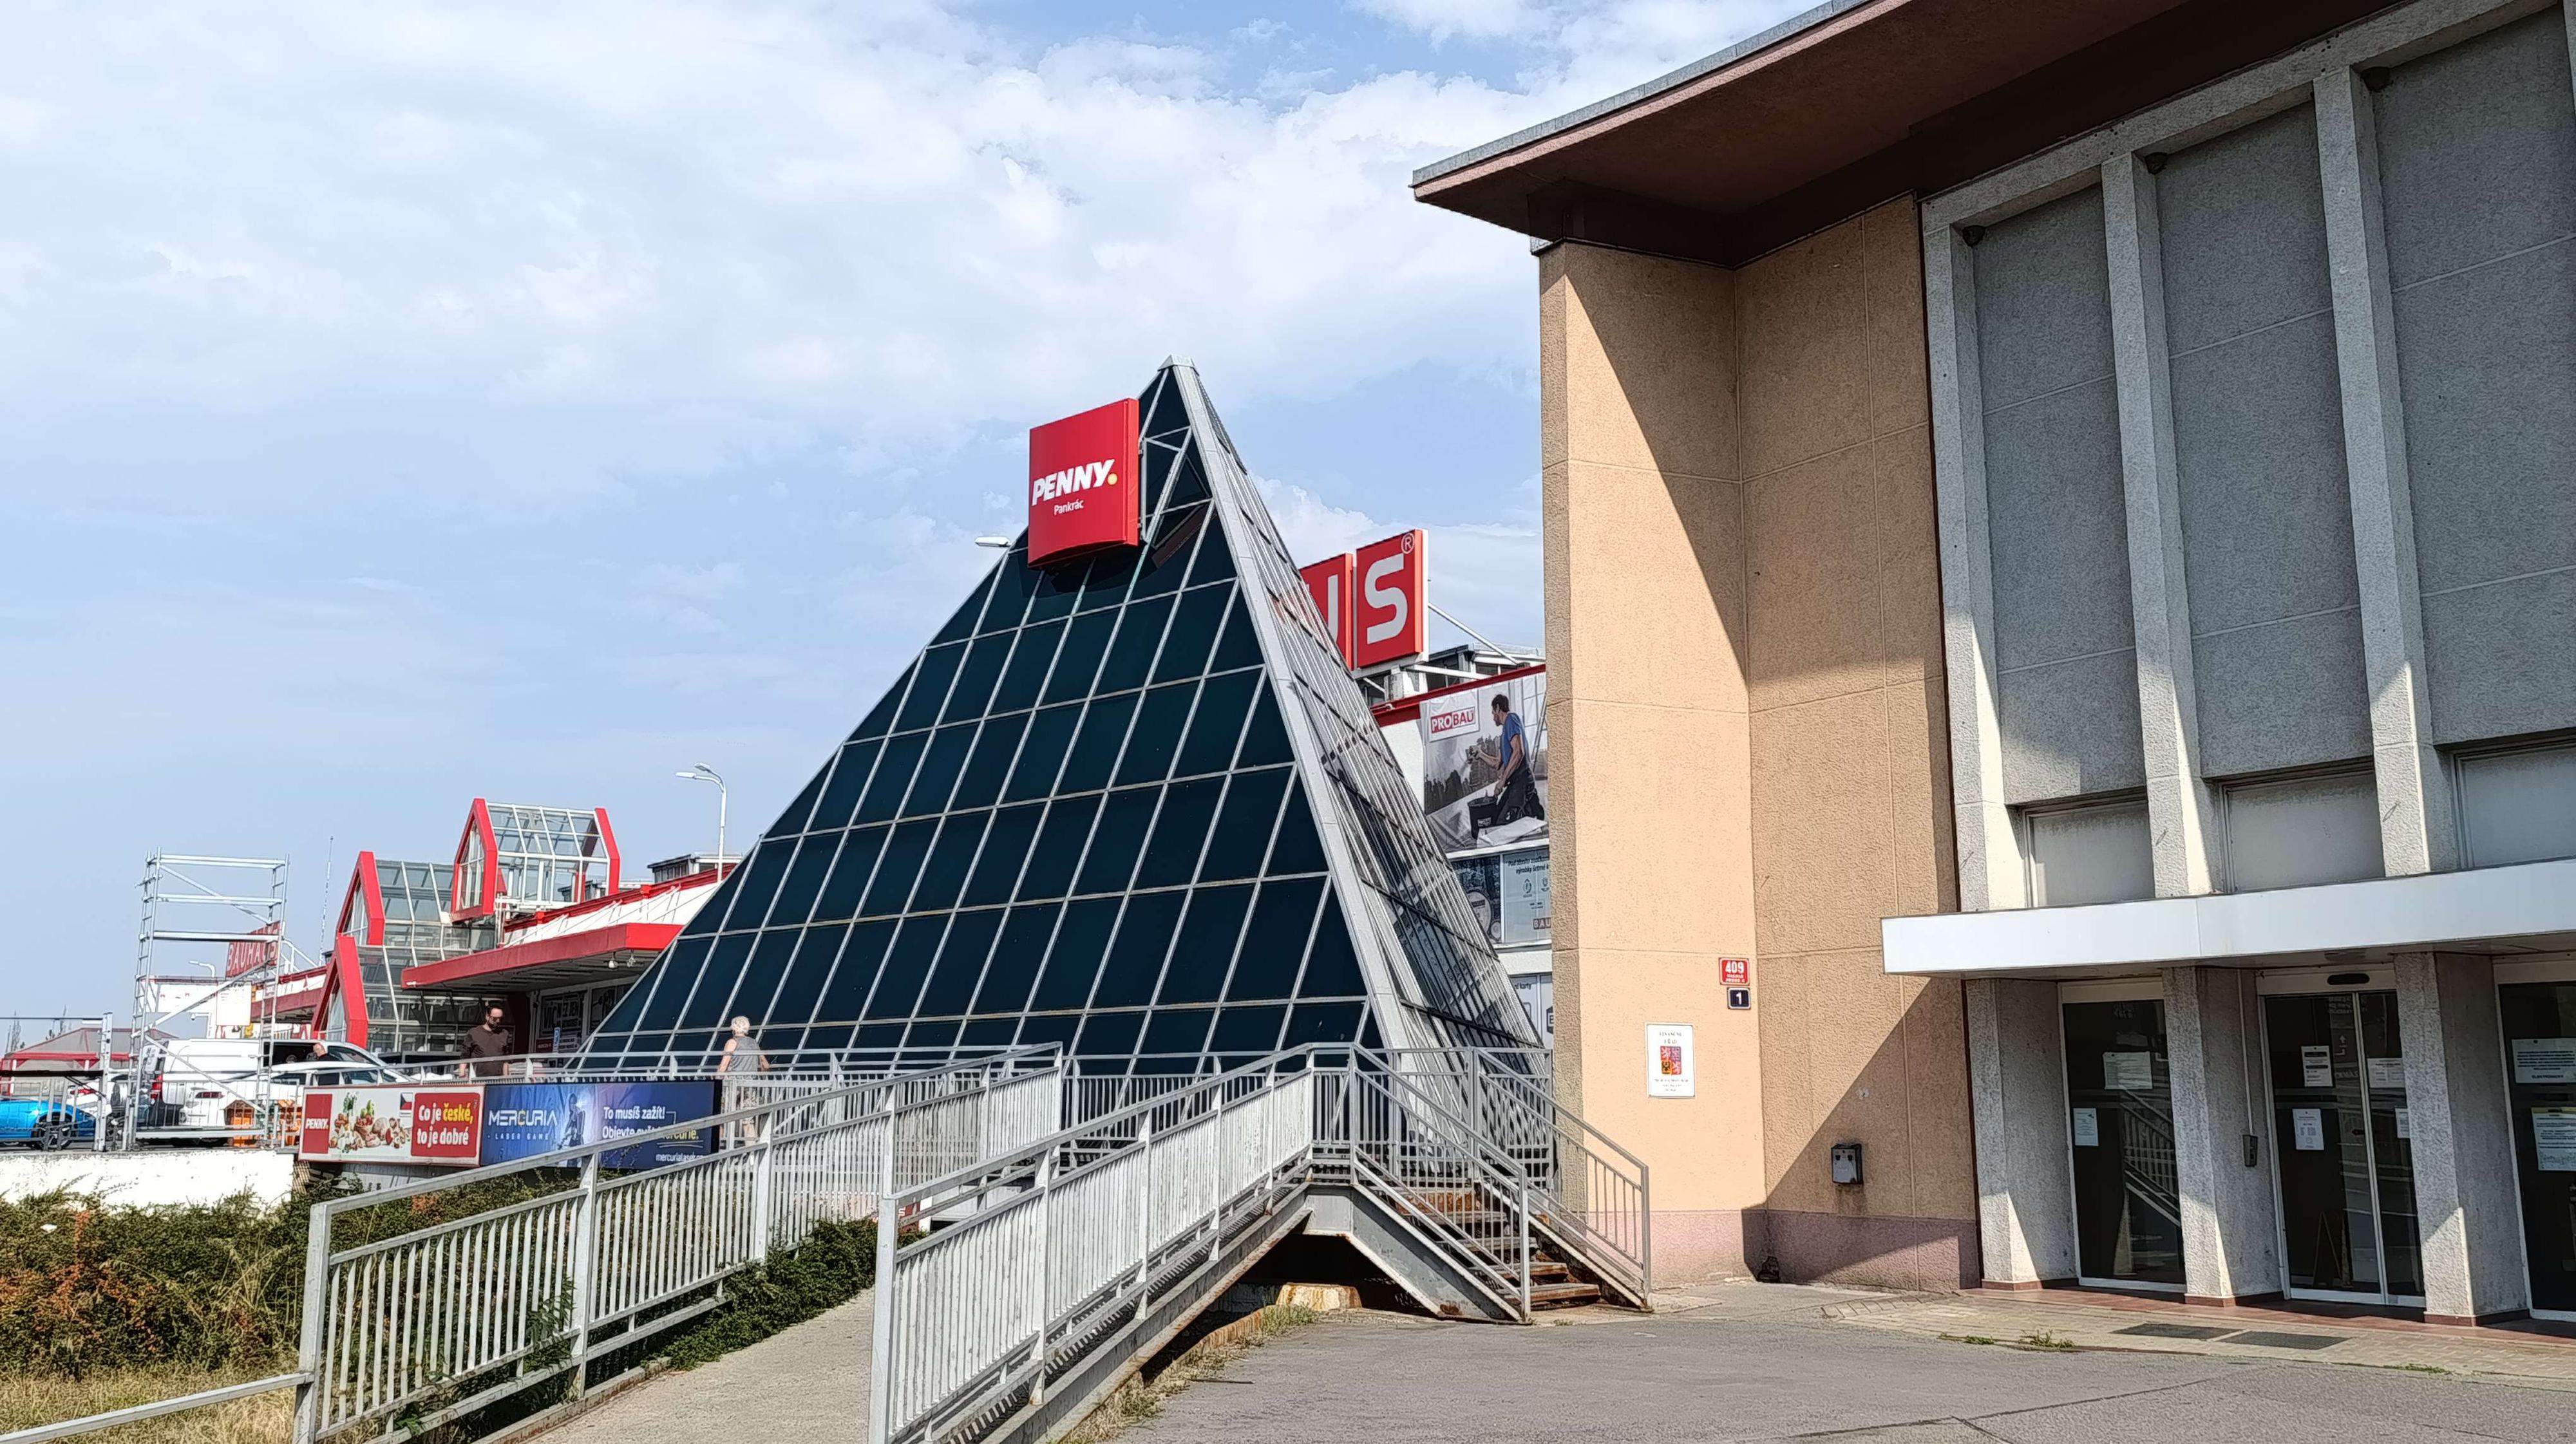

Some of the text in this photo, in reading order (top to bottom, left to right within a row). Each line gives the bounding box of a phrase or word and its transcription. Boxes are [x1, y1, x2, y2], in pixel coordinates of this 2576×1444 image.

[1031, 459, 1118, 506] PENNY.
[1054, 499, 1084, 515] Pankrác
[1432, 709, 1474, 731] PROBAU
[1725, 960, 1744, 974] 409
[1736, 991, 1742, 1005] 1
[419, 1105, 430, 1121] Co
[430, 1105, 441, 1126] je
[442, 1102, 473, 1125] české,
[488, 1109, 558, 1127] MERCURIA
[603, 1105, 666, 1120] To musíš zažít!
[305, 1118, 329, 1129] PENNY.
[417, 1127, 469, 1149] to je dobré
[602, 1125, 635, 1139] Objevte
